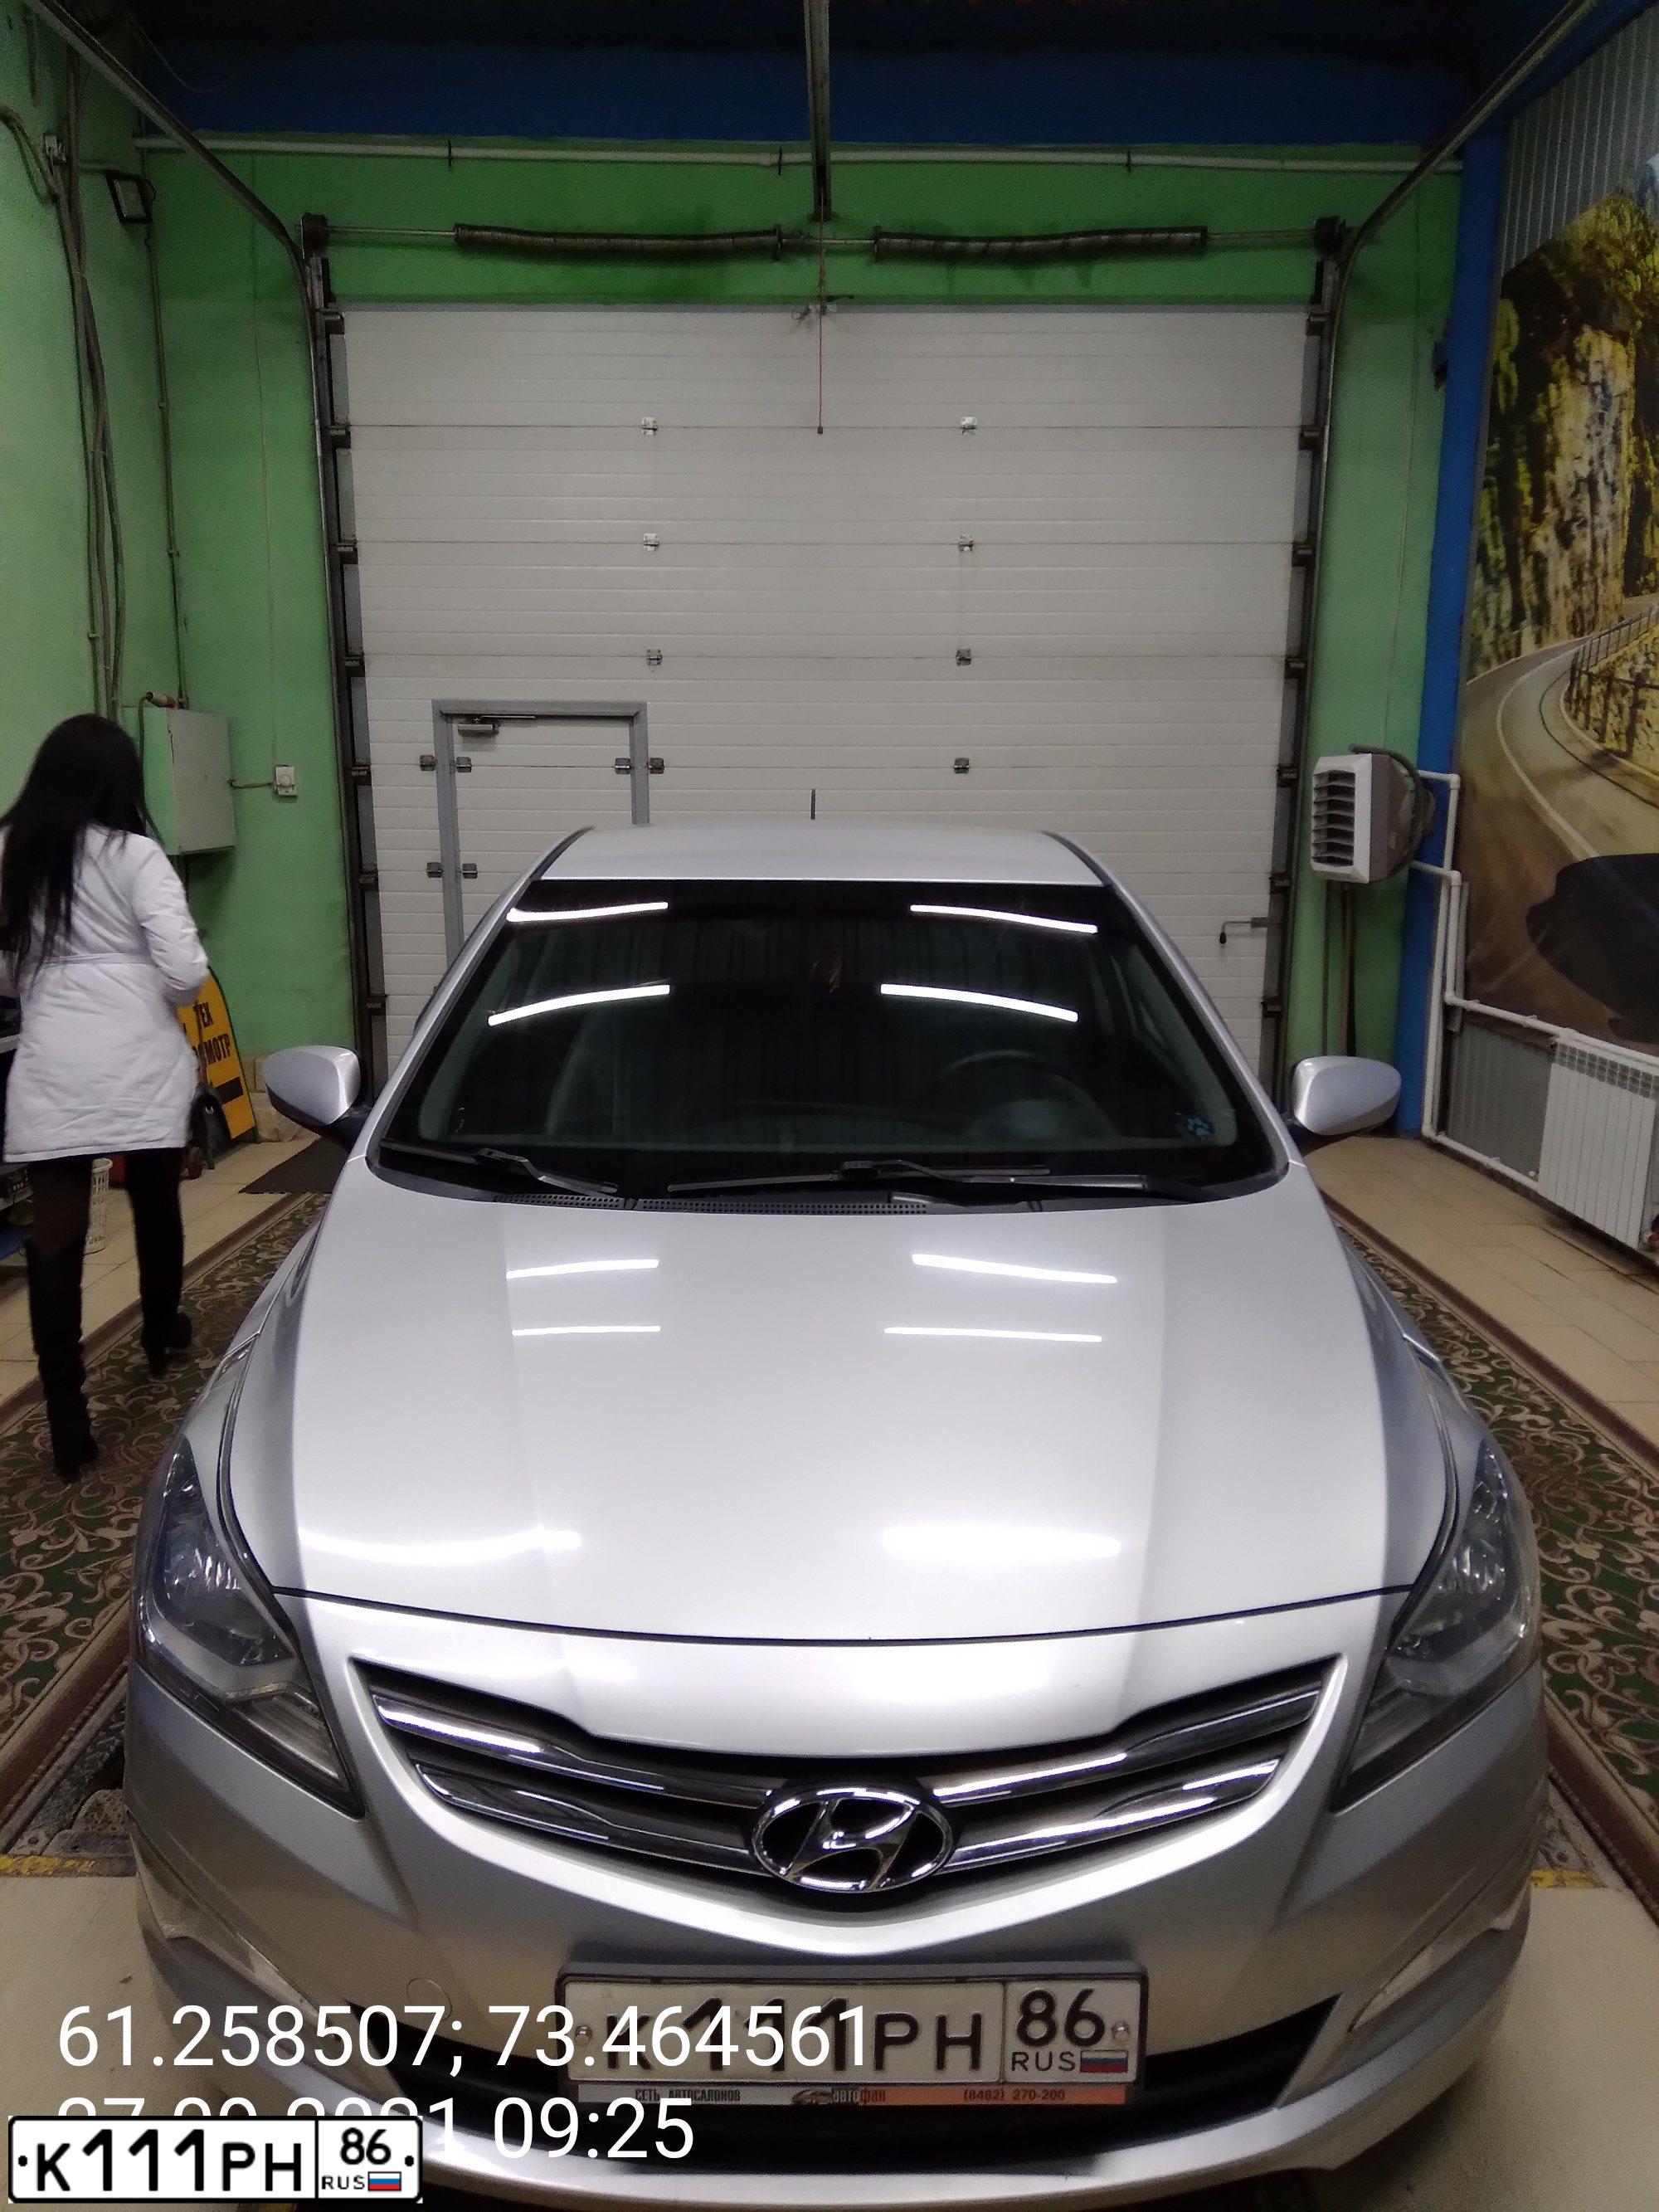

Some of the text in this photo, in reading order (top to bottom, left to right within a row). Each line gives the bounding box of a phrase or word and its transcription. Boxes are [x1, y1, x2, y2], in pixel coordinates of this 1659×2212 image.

[1016, 1987, 1105, 2047] 86
[1011, 2051, 1076, 2072] RUS
[635, 2088, 660, 2102] СЕТЬ
